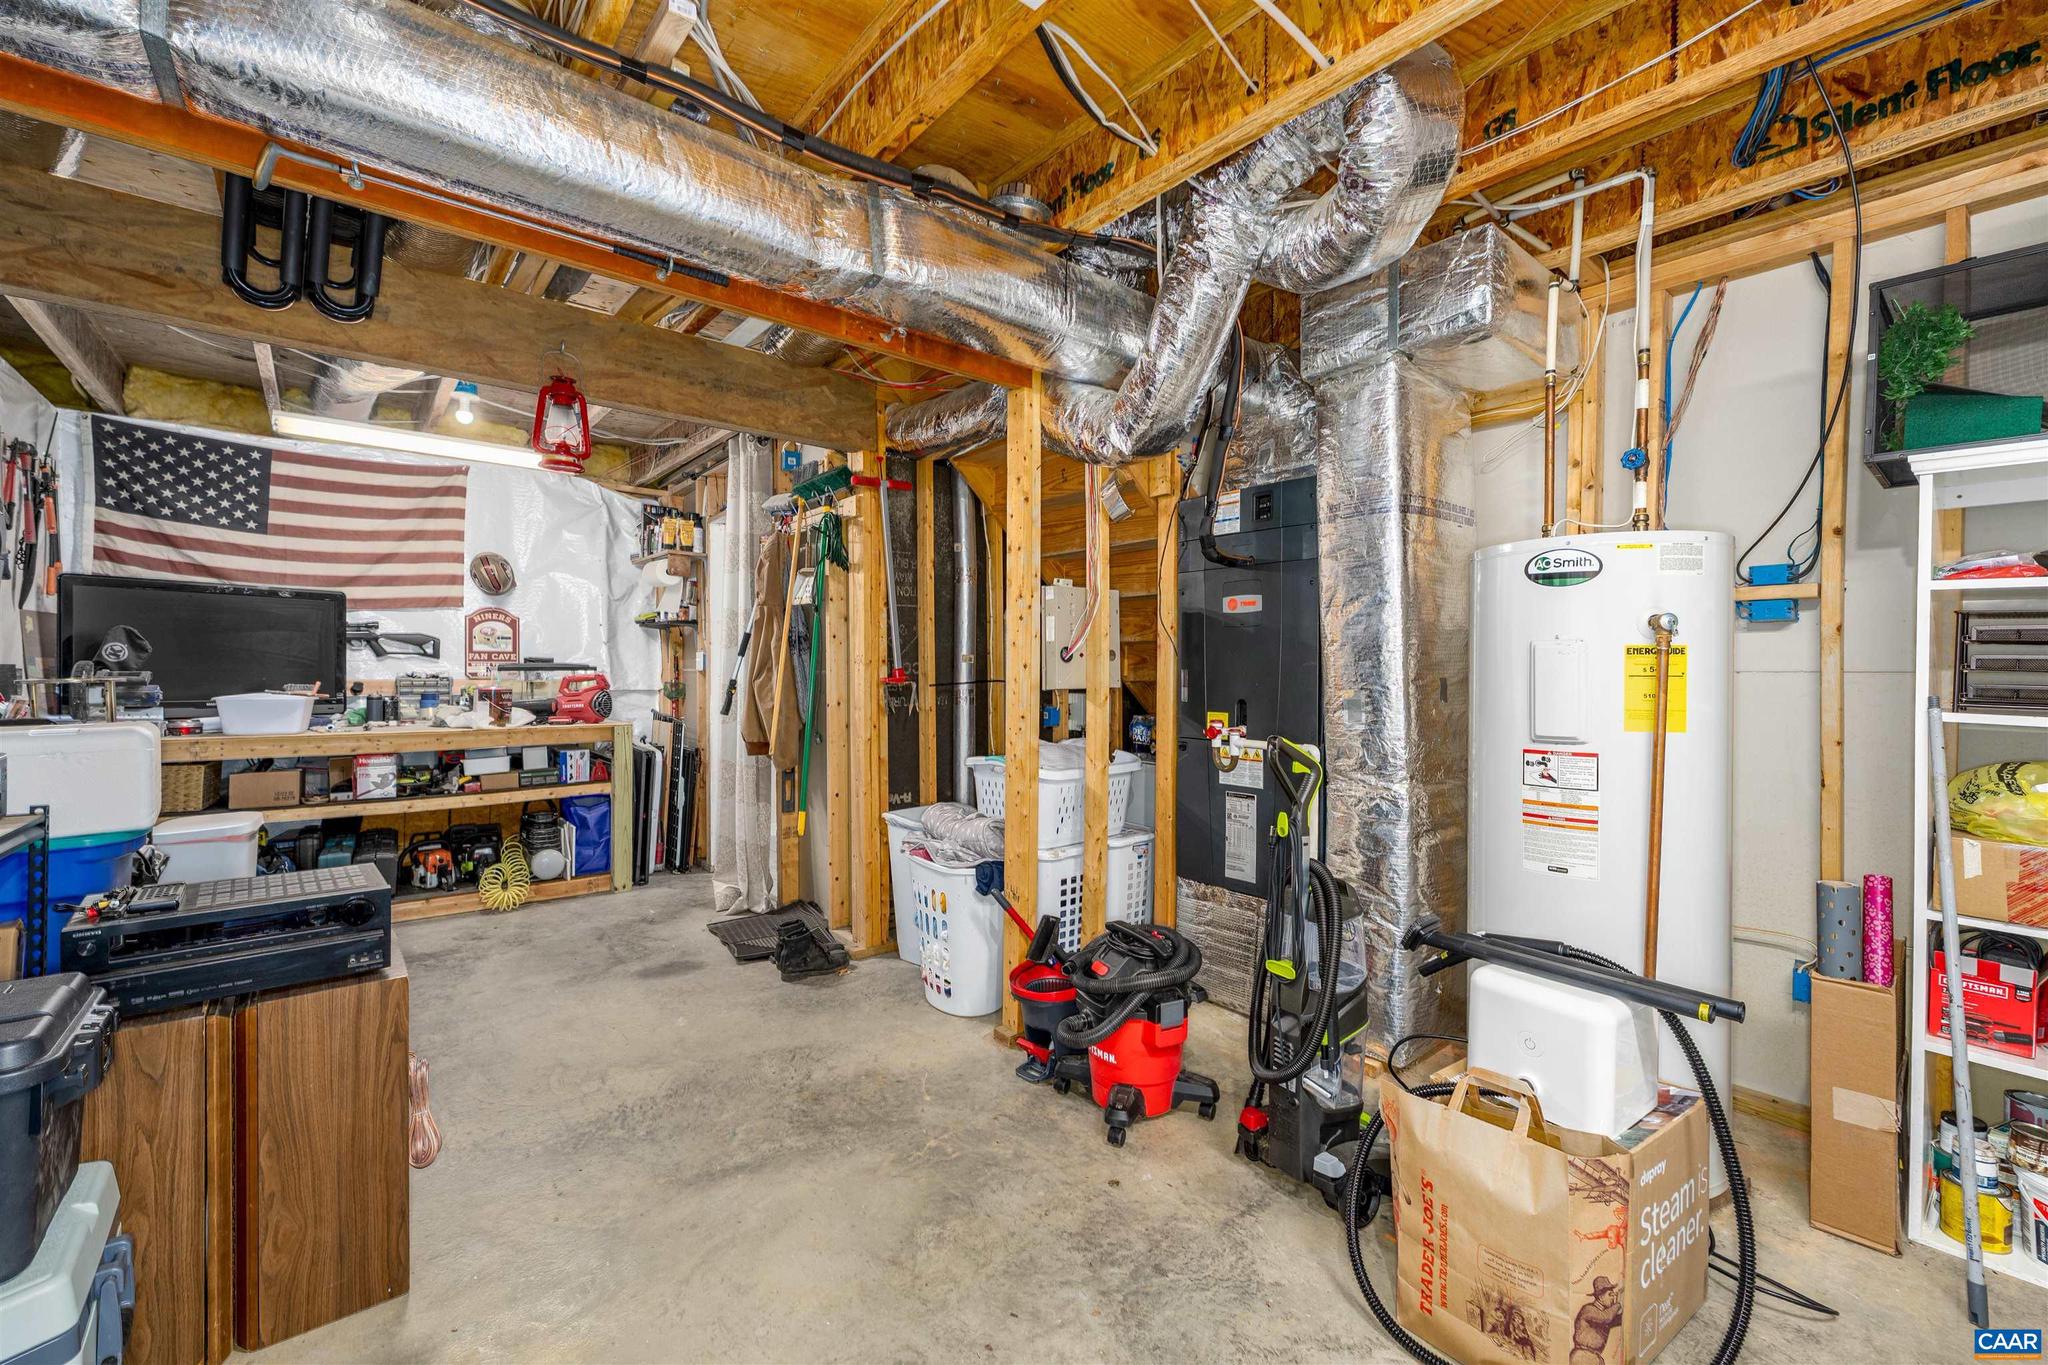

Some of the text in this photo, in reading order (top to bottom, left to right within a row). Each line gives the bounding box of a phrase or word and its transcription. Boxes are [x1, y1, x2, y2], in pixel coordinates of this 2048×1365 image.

[1553, 556, 1593, 569] Smith
[473, 612, 512, 623] NINERS
[468, 652, 517, 660] FAN CAVE
[1626, 647, 1686, 655] ENERGUIDE
[1942, 978, 2005, 996] CFTSMAN
[1640, 1159, 1667, 1187] dupray
[1640, 1163, 1708, 1247] Steam is
[1419, 1175, 1435, 1317] TRADER JOE'S
[1640, 1208, 1704, 1289] cleaner.
